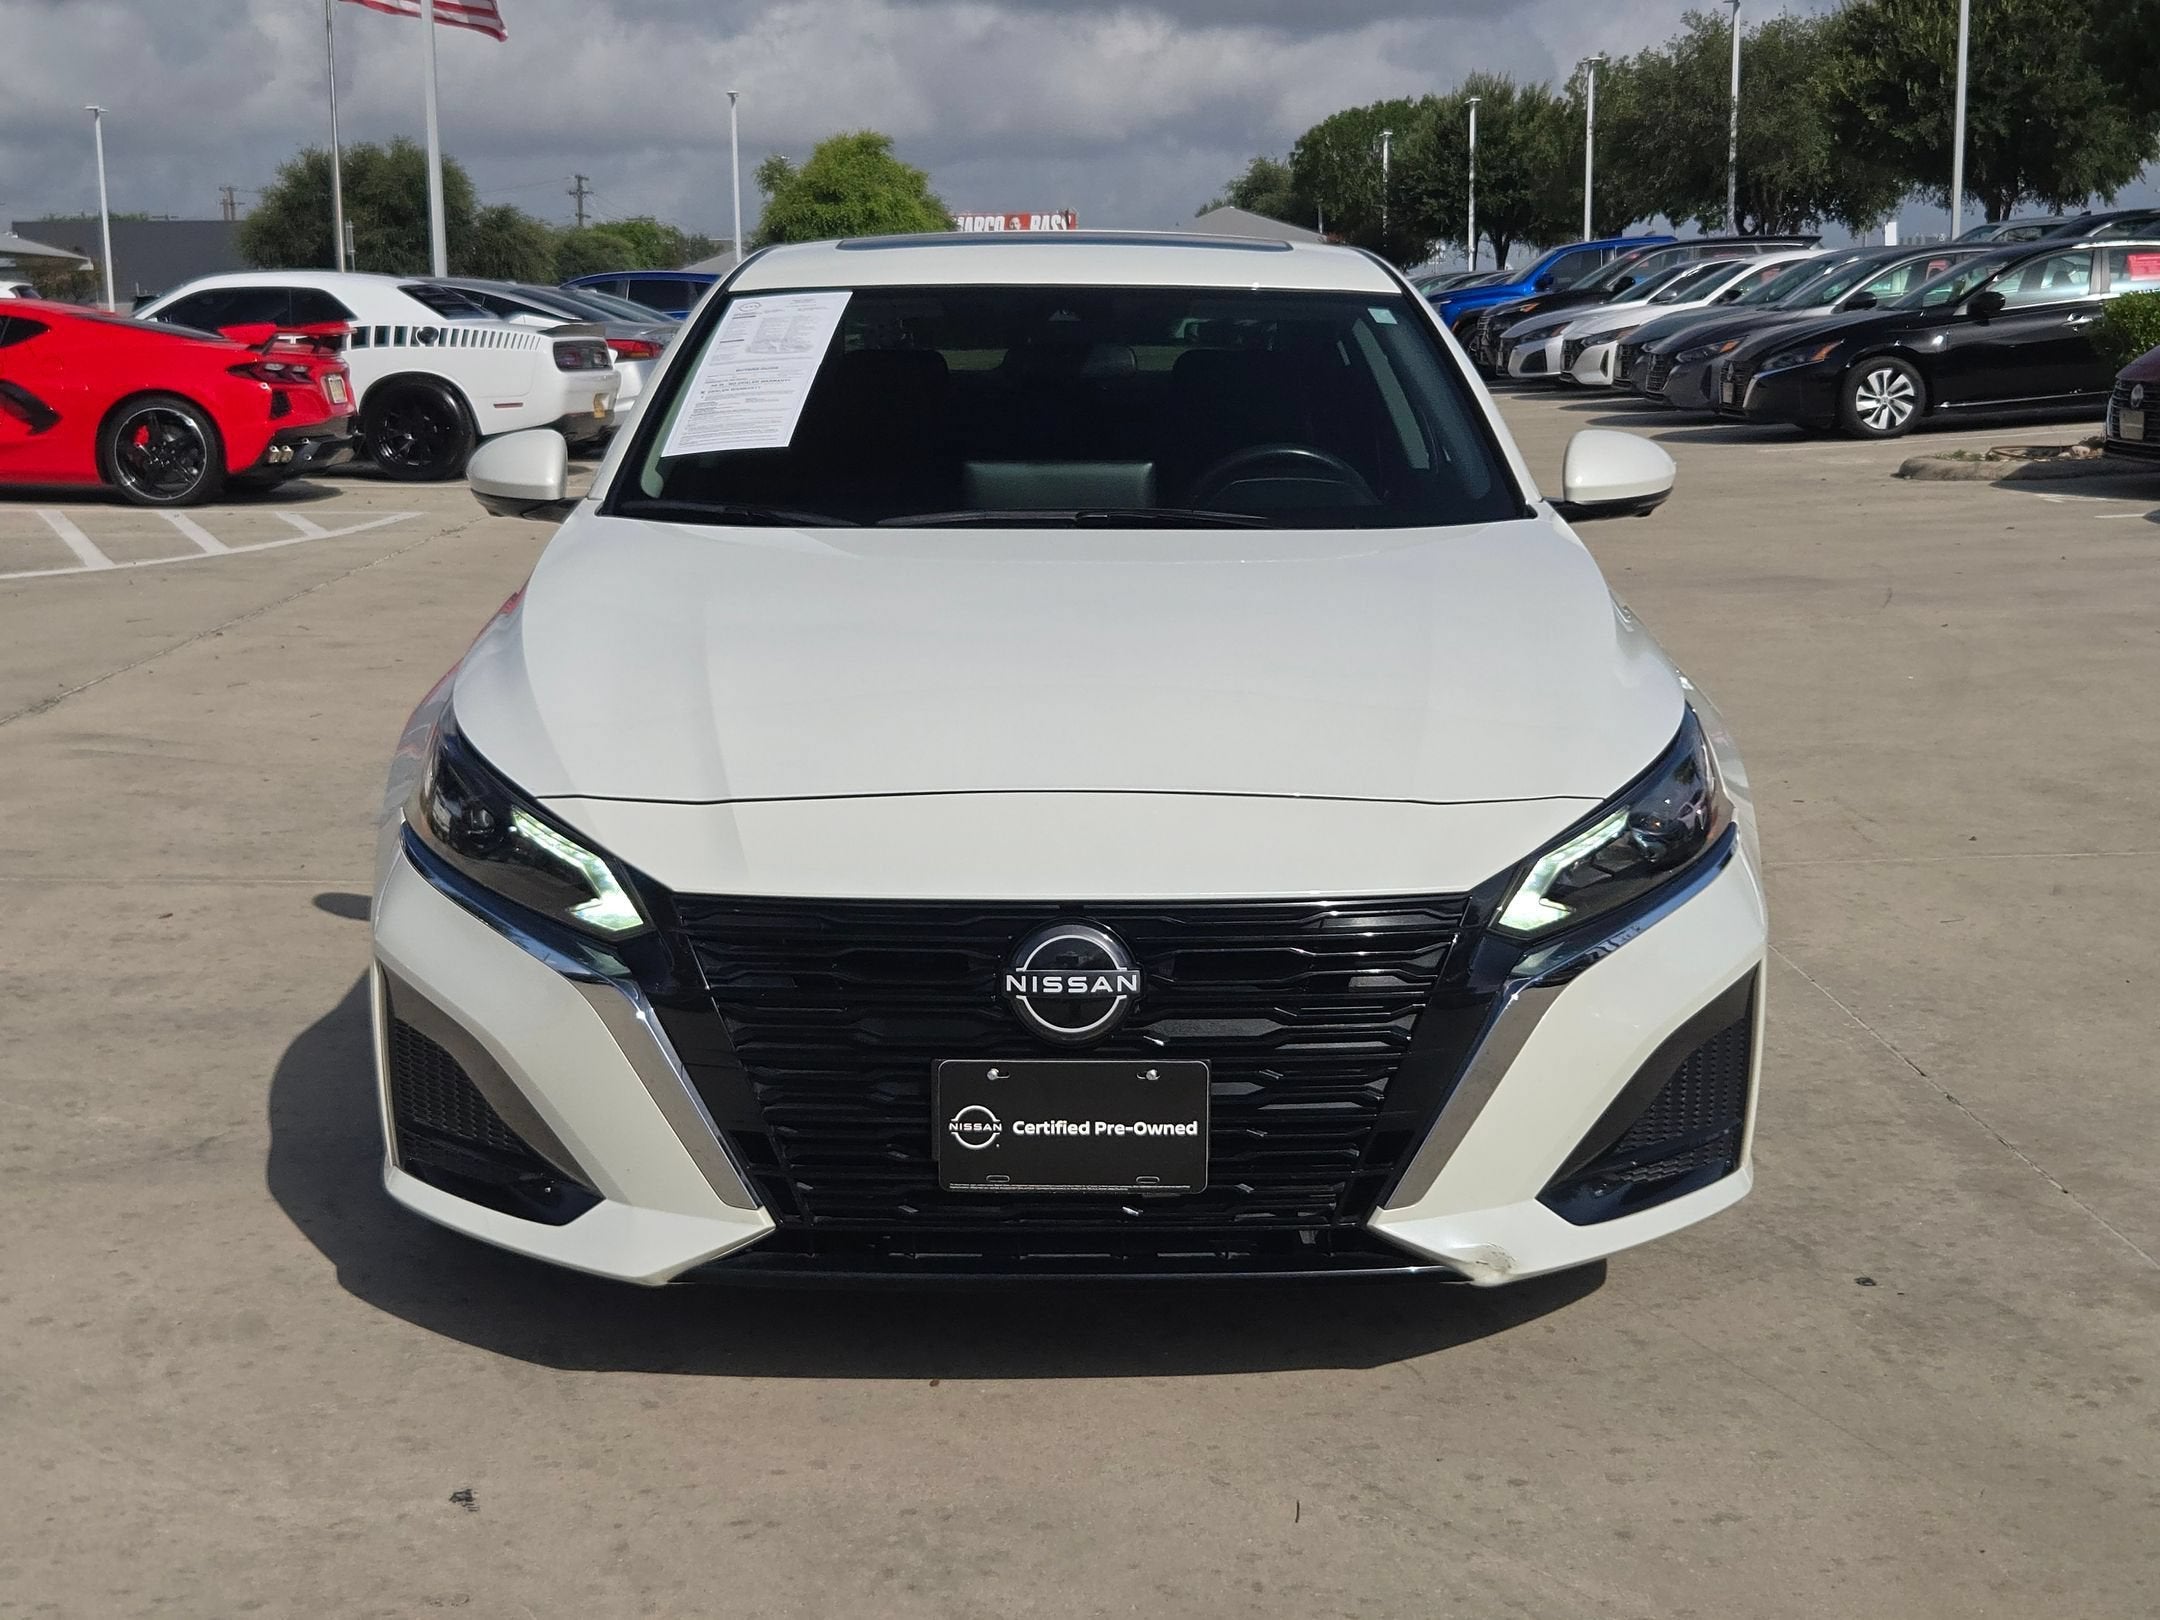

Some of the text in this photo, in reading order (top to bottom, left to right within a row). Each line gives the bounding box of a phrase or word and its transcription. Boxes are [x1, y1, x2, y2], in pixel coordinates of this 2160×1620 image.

[1006, 974, 1137, 993] NISSAN
[949, 1122, 1002, 1131] NISSAN
[1012, 1120, 1198, 1136] Certified Pre-Owned
